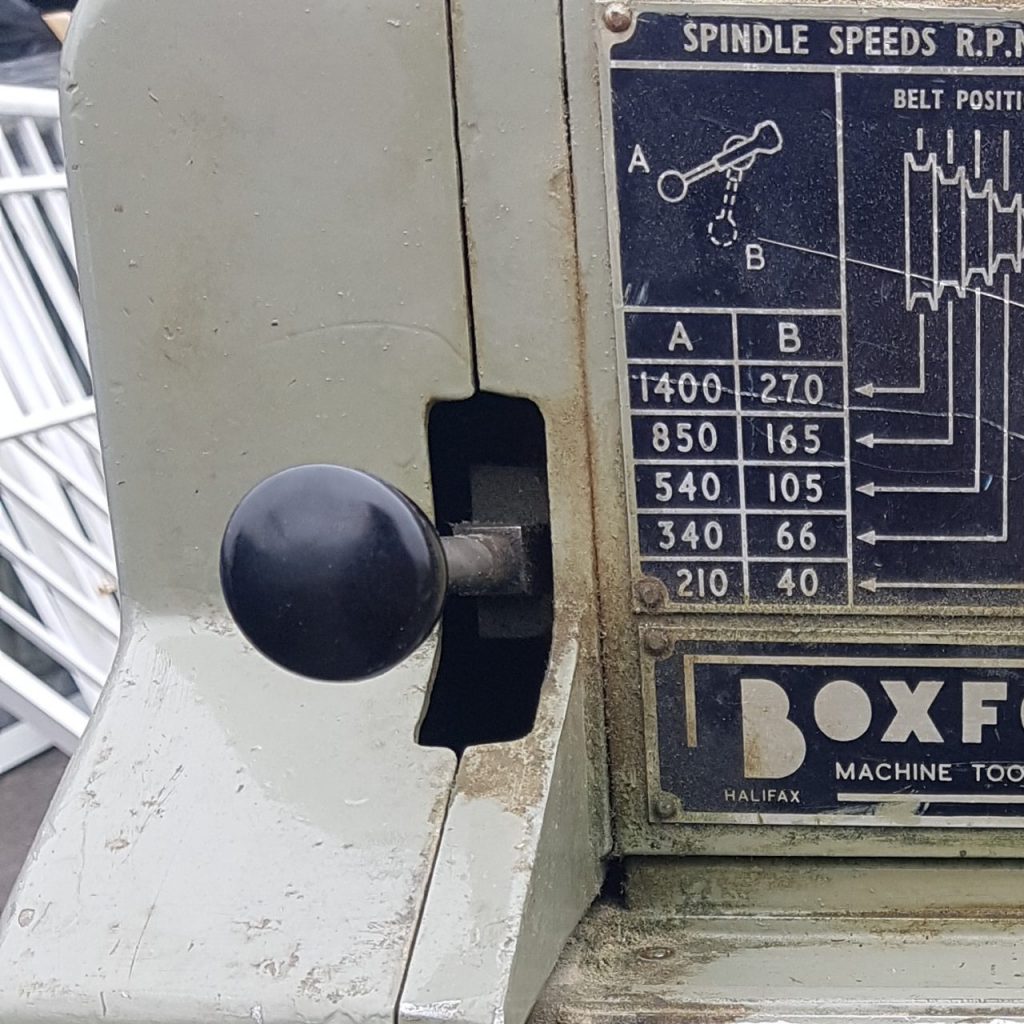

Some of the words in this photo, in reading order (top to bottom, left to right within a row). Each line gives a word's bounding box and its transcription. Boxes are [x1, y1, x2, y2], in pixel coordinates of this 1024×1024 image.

[683, 23, 809, 55] SPINDLE
[829, 25, 936, 57] SPEEDS
[894, 88, 943, 111] BELT
[628, 145, 651, 173] A
[745, 245, 766, 271] B
[668, 323, 694, 352] A
[779, 324, 802, 352] B
[640, 373, 722, 403] 1400
[760, 374, 824, 404] 270
[651, 423, 718, 453] 850
[766, 424, 821, 454] 165
[655, 473, 721, 502] 540
[769, 473, 823, 502] 105
[658, 521, 724, 549] 340
[776, 522, 817, 549] 66
[677, 570, 728, 597] 210
[777, 568, 818, 597] 40
[835, 762, 952, 783] MACHINE
[724, 788, 801, 805] HALIFAX
